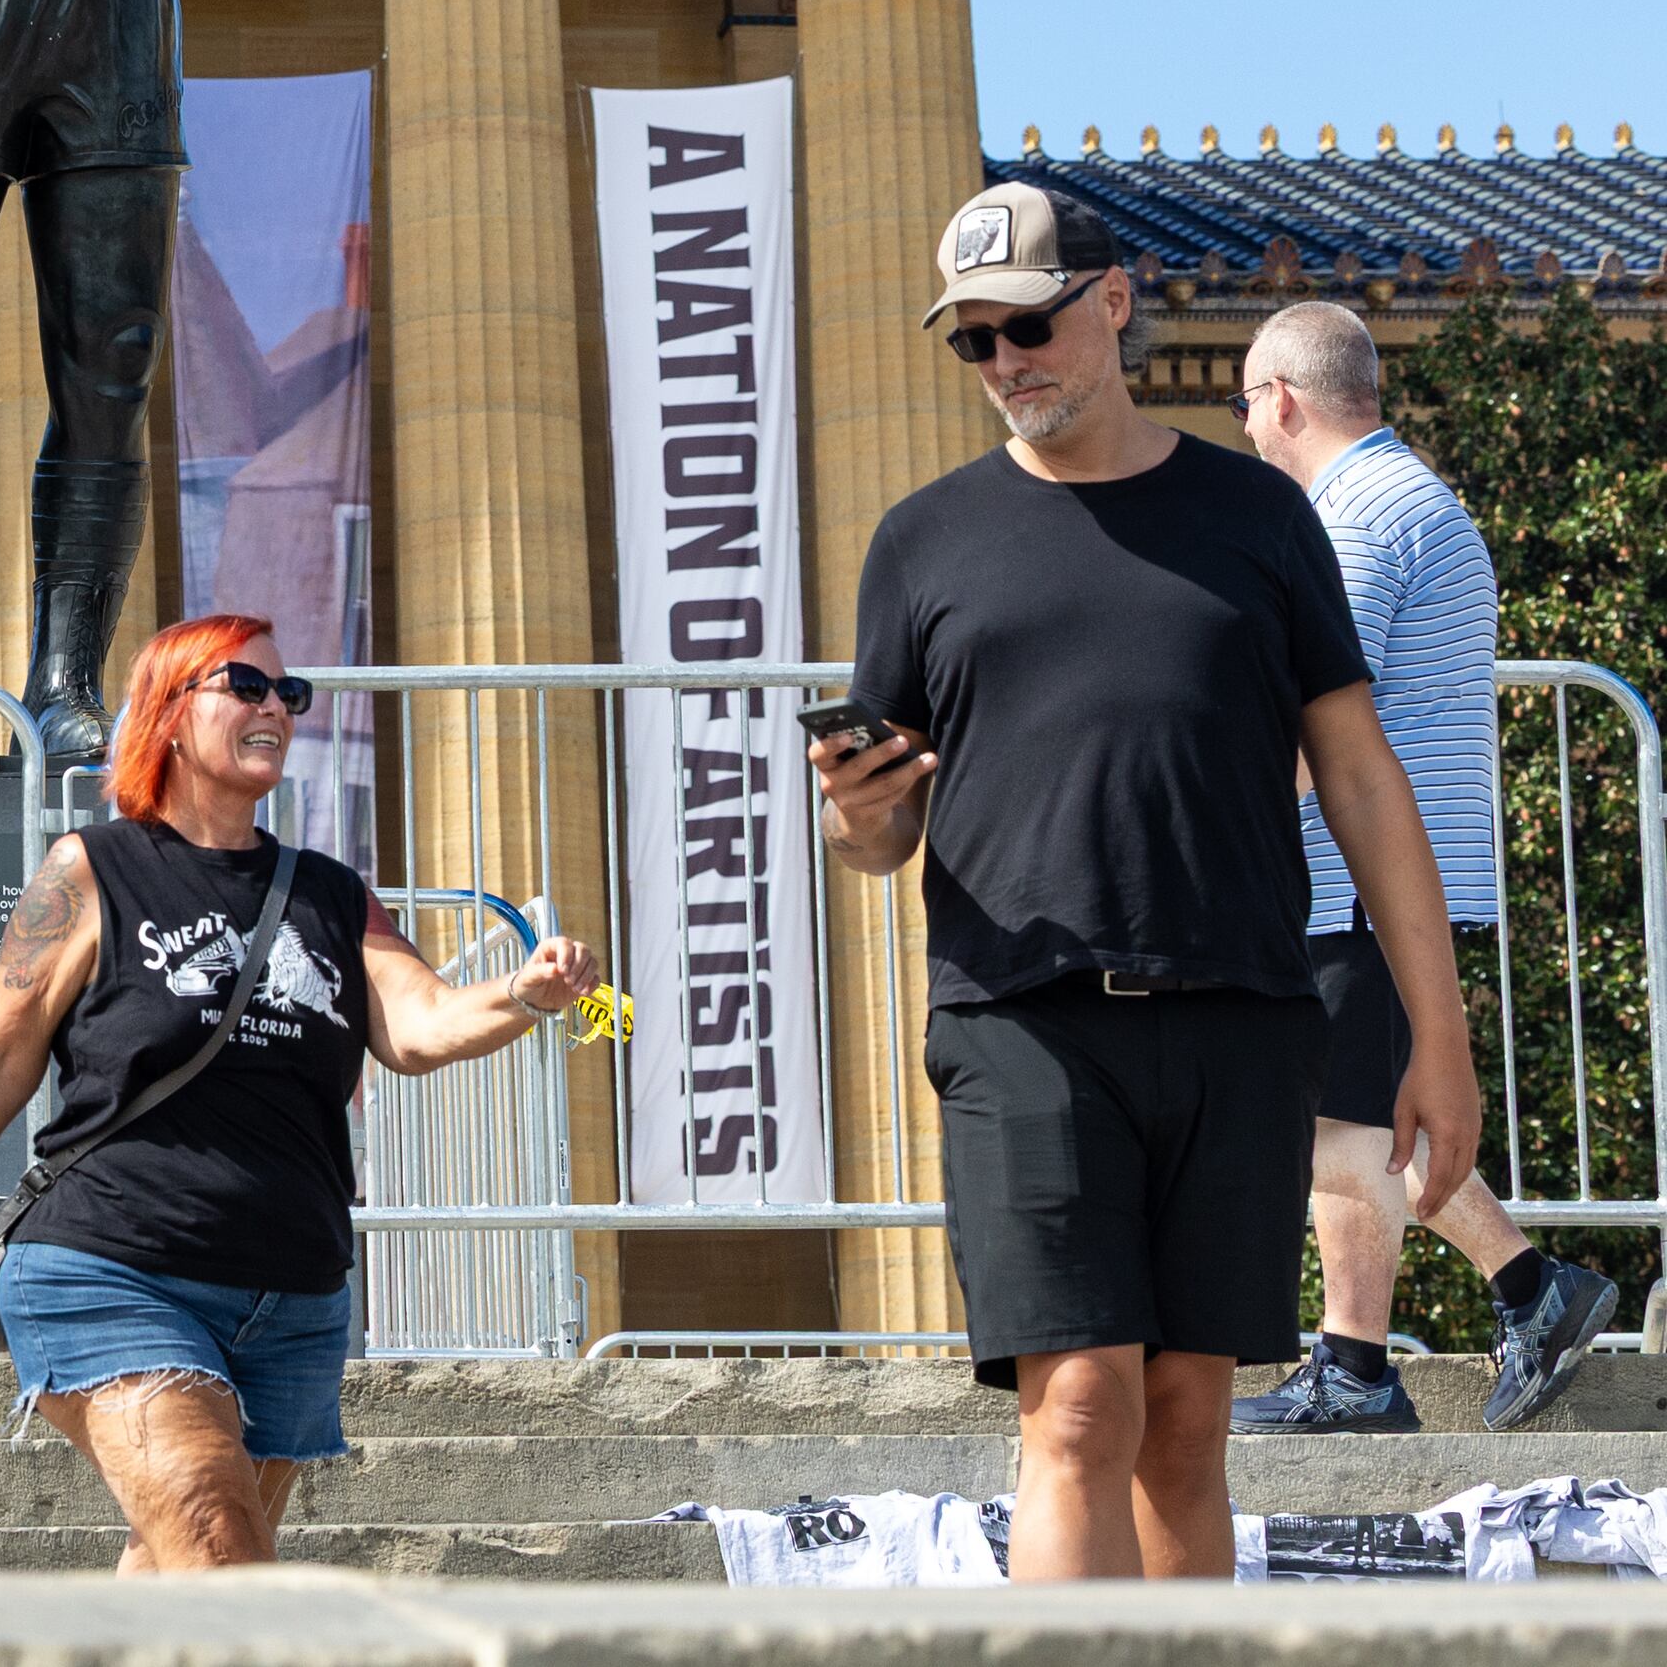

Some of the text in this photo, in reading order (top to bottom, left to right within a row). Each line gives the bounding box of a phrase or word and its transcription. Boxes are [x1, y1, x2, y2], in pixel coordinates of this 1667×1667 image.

[647, 123, 779, 1178] A NATION OF ARTISTS
[138, 911, 227, 970] SWEAT
[240, 1014, 303, 1039] FLORIDA
